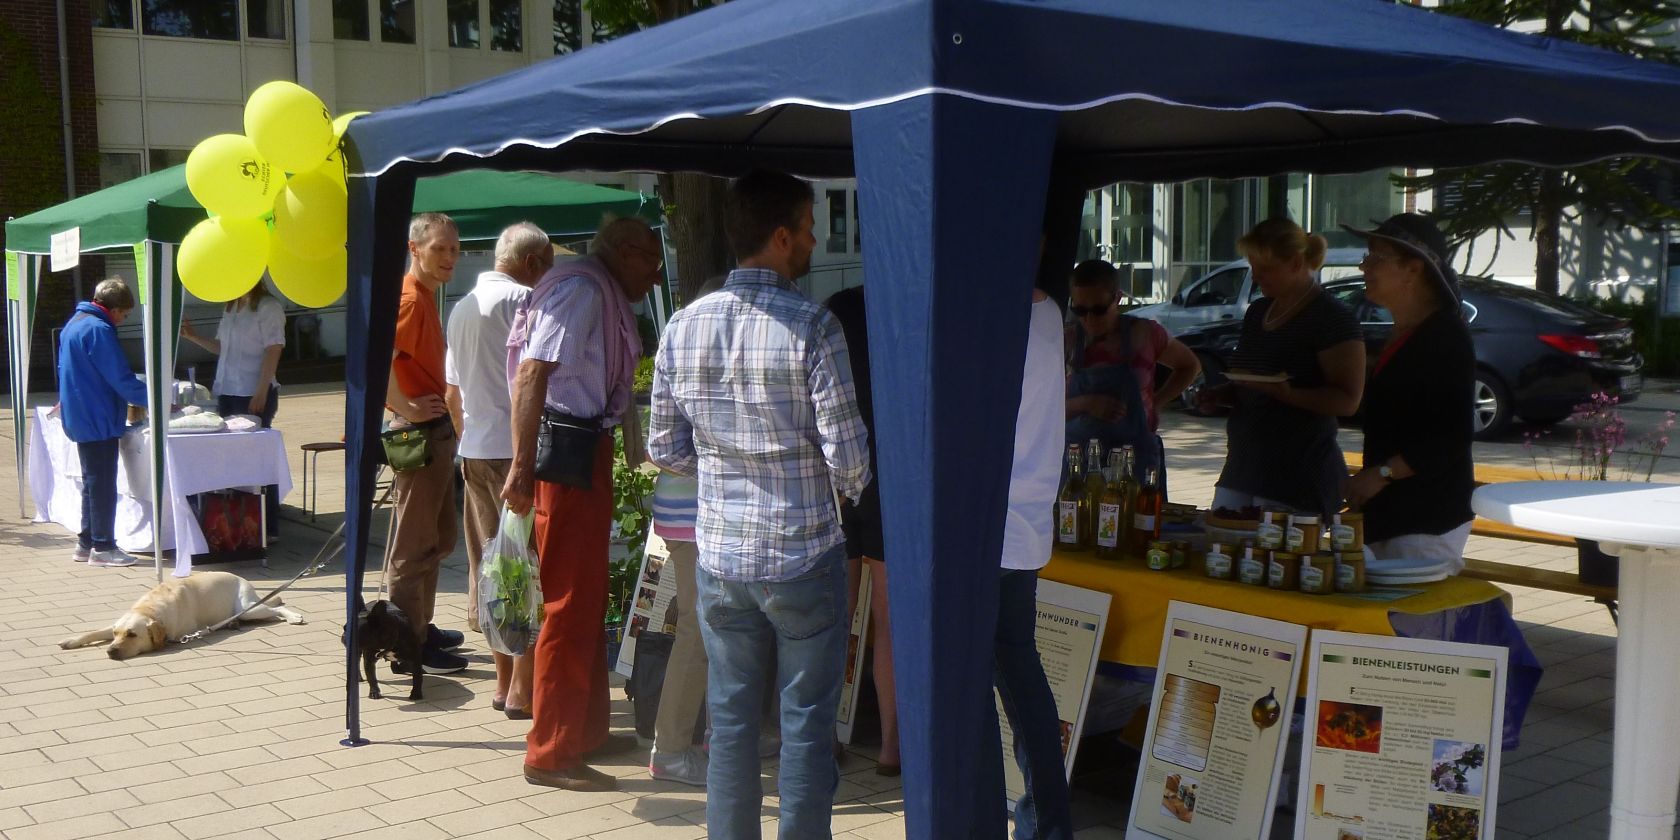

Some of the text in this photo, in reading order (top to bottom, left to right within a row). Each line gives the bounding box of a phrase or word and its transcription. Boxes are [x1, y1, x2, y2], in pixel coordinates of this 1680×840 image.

[1036, 611, 1079, 627] ENWUNDER
[1193, 633, 1270, 657] BIENENHONIG
[1352, 657, 1460, 675] BIENENLEISTUNGEN
